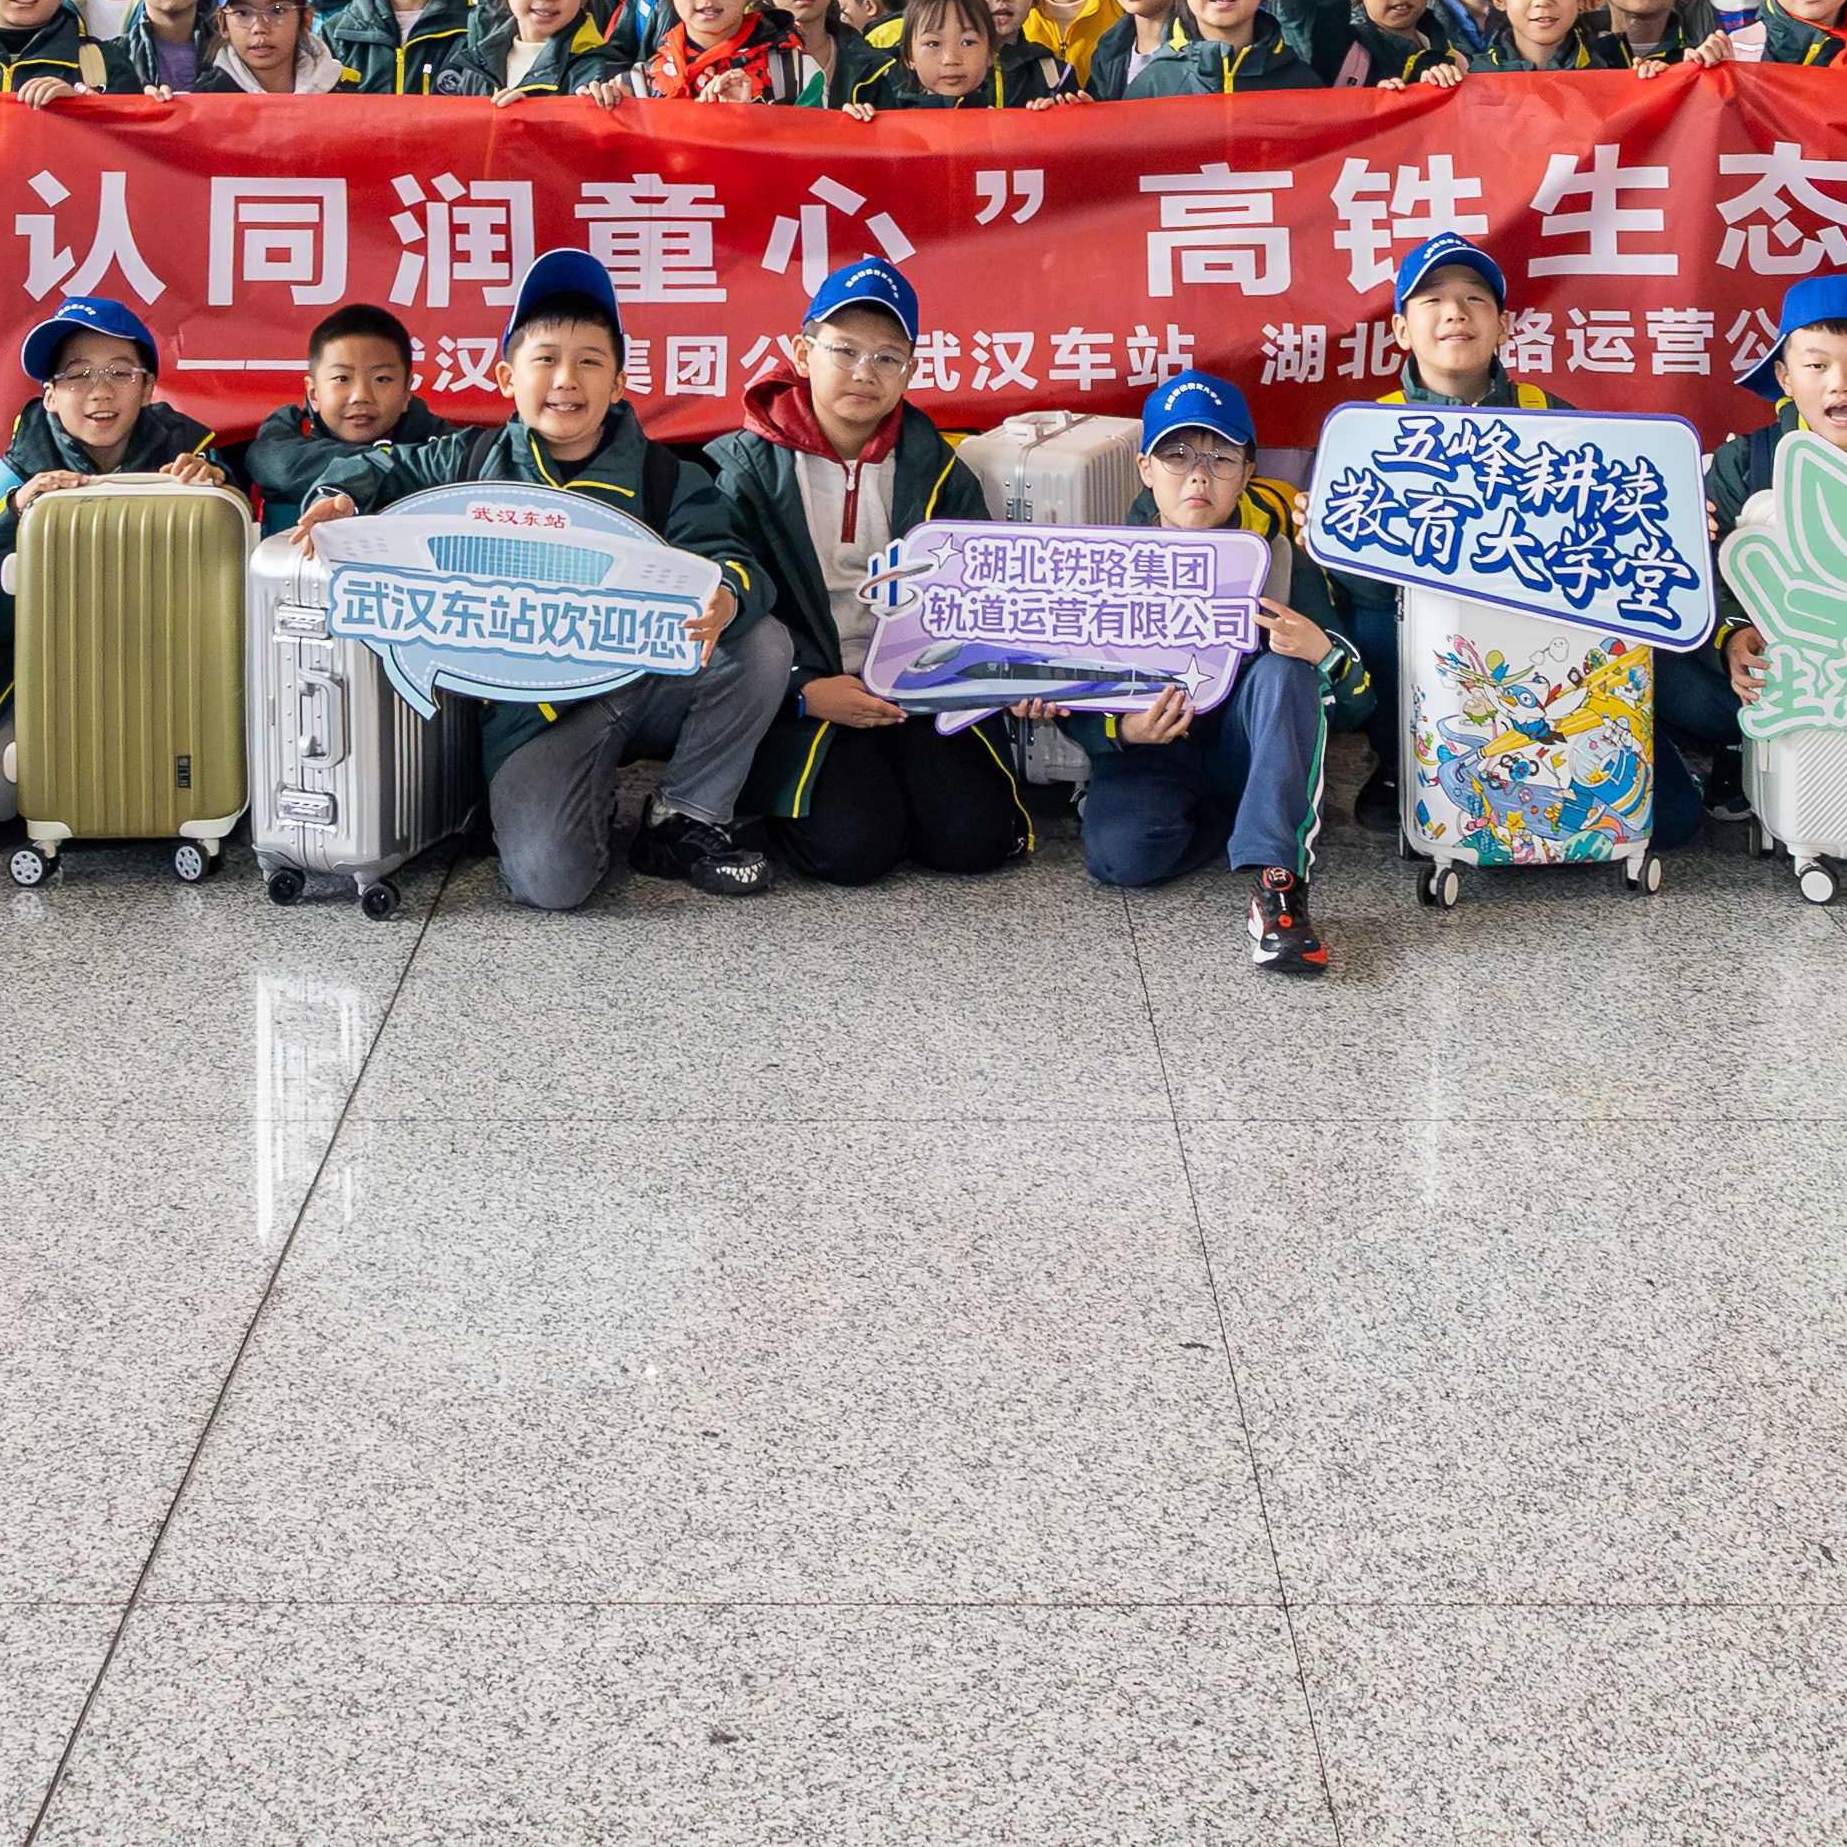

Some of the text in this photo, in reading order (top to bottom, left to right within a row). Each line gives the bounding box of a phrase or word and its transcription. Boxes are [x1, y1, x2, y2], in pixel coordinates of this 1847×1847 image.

[15, 168, 1045, 308] 认同润童心”
[1259, 306, 1784, 388] 湖北路运营公
[471, 505, 567, 531] 武汉东站
[1374, 418, 1662, 538] 五峰耕读
[968, 545, 1210, 593] 湖北铁路集团
[1324, 470, 1695, 622] 教育大学堂
[342, 581, 691, 660] 武汉东站欢迎您
[928, 595, 1254, 644] 轨道运营有限公司
